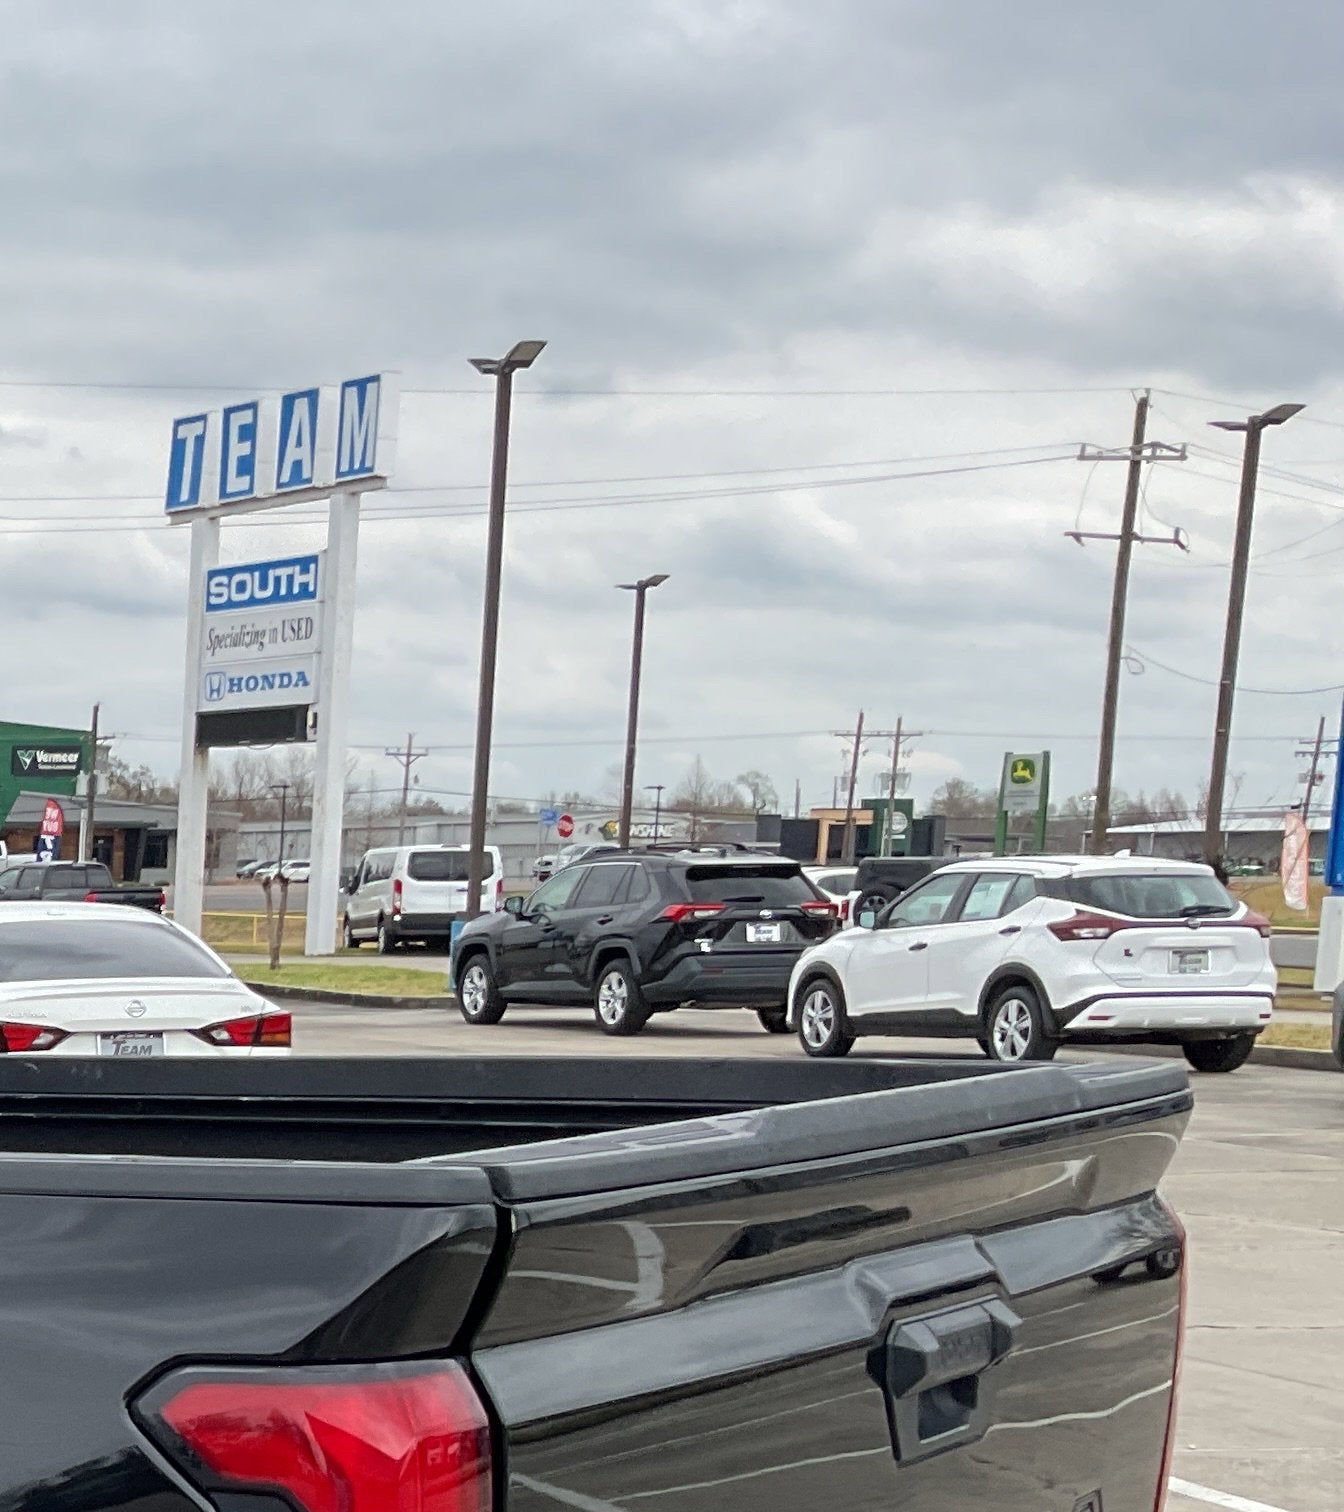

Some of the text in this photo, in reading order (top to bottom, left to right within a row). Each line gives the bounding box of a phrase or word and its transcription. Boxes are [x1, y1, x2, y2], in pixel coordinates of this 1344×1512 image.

[177, 381, 380, 502] TEAM
[208, 563, 316, 605] SOUTH
[206, 617, 313, 656] Specializing in USED
[227, 671, 310, 693] HONDA
